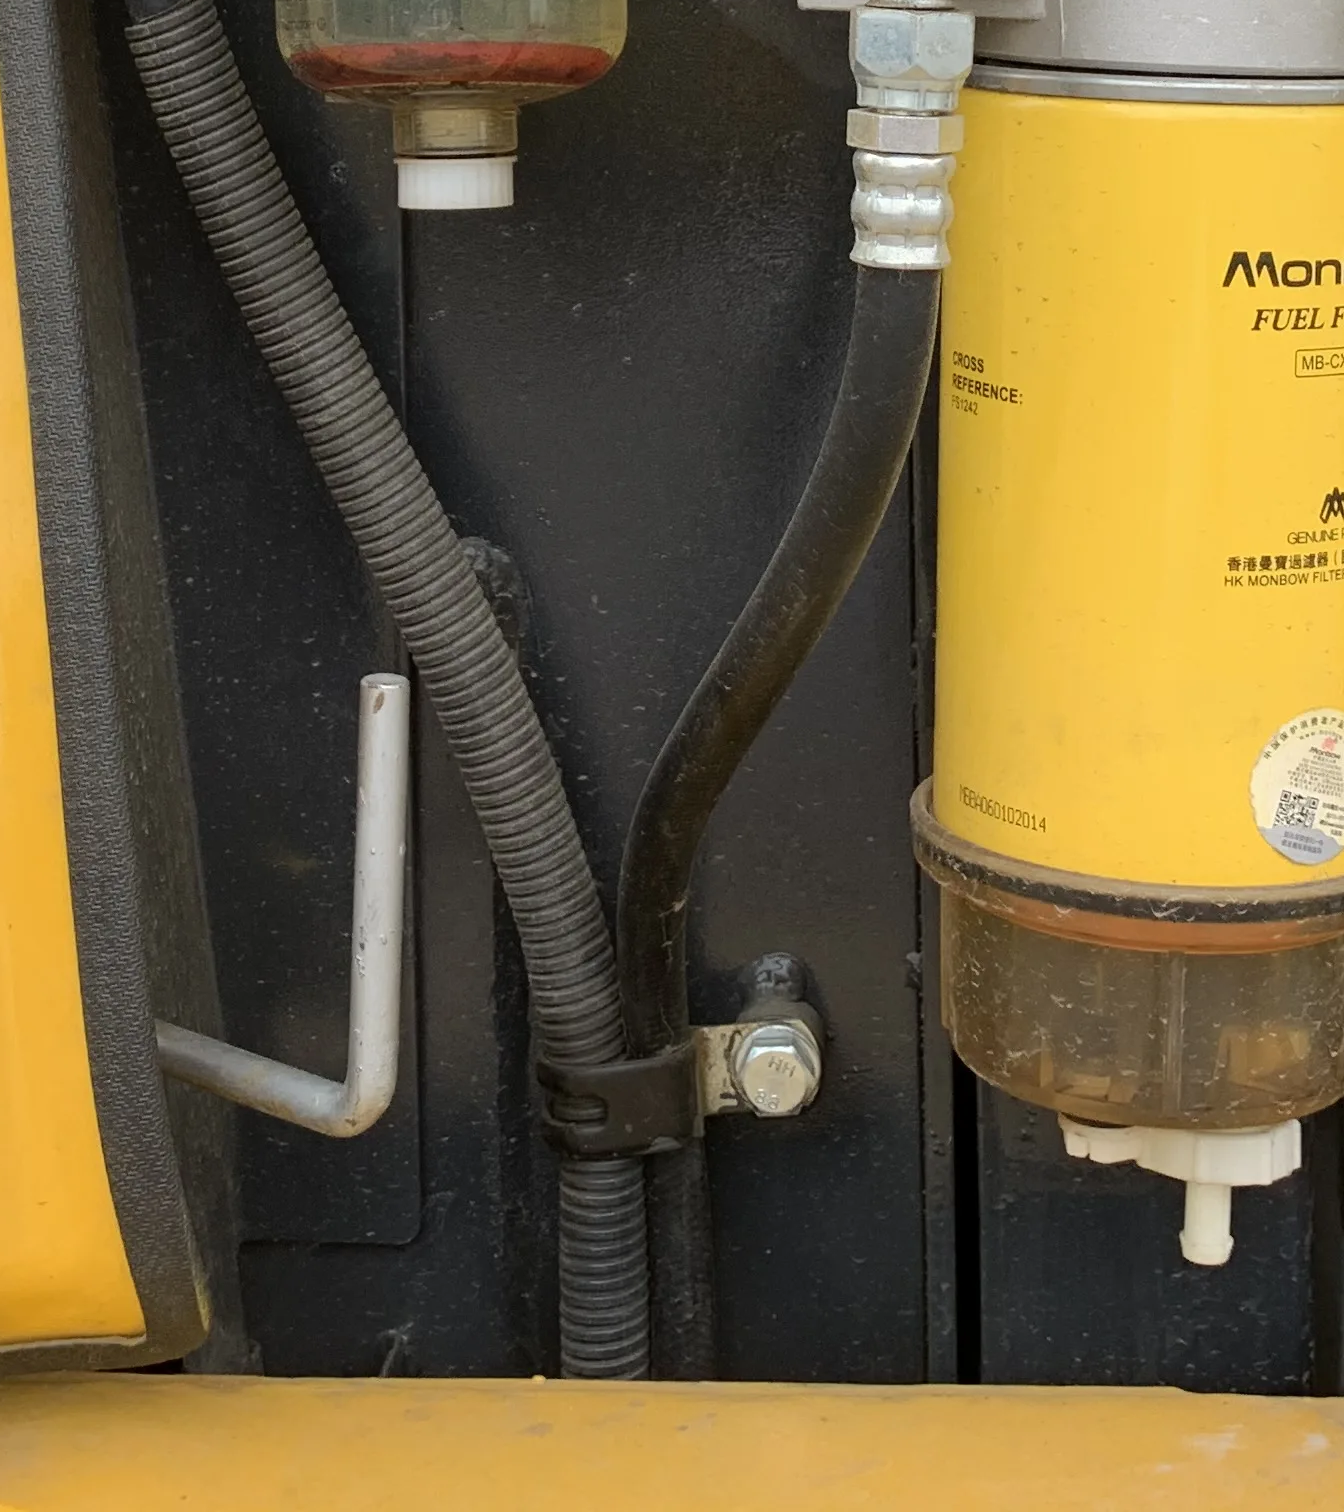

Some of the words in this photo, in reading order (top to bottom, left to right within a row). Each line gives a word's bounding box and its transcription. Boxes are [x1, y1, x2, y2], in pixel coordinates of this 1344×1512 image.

[1251, 307, 1325, 331] FUEL
[952, 350, 984, 374] CROSS
[952, 373, 1023, 405] REFERENCE:
[1287, 528, 1339, 545] GENUINE
[1224, 575, 1244, 588] HK
[1247, 572, 1310, 587] MONBOW
